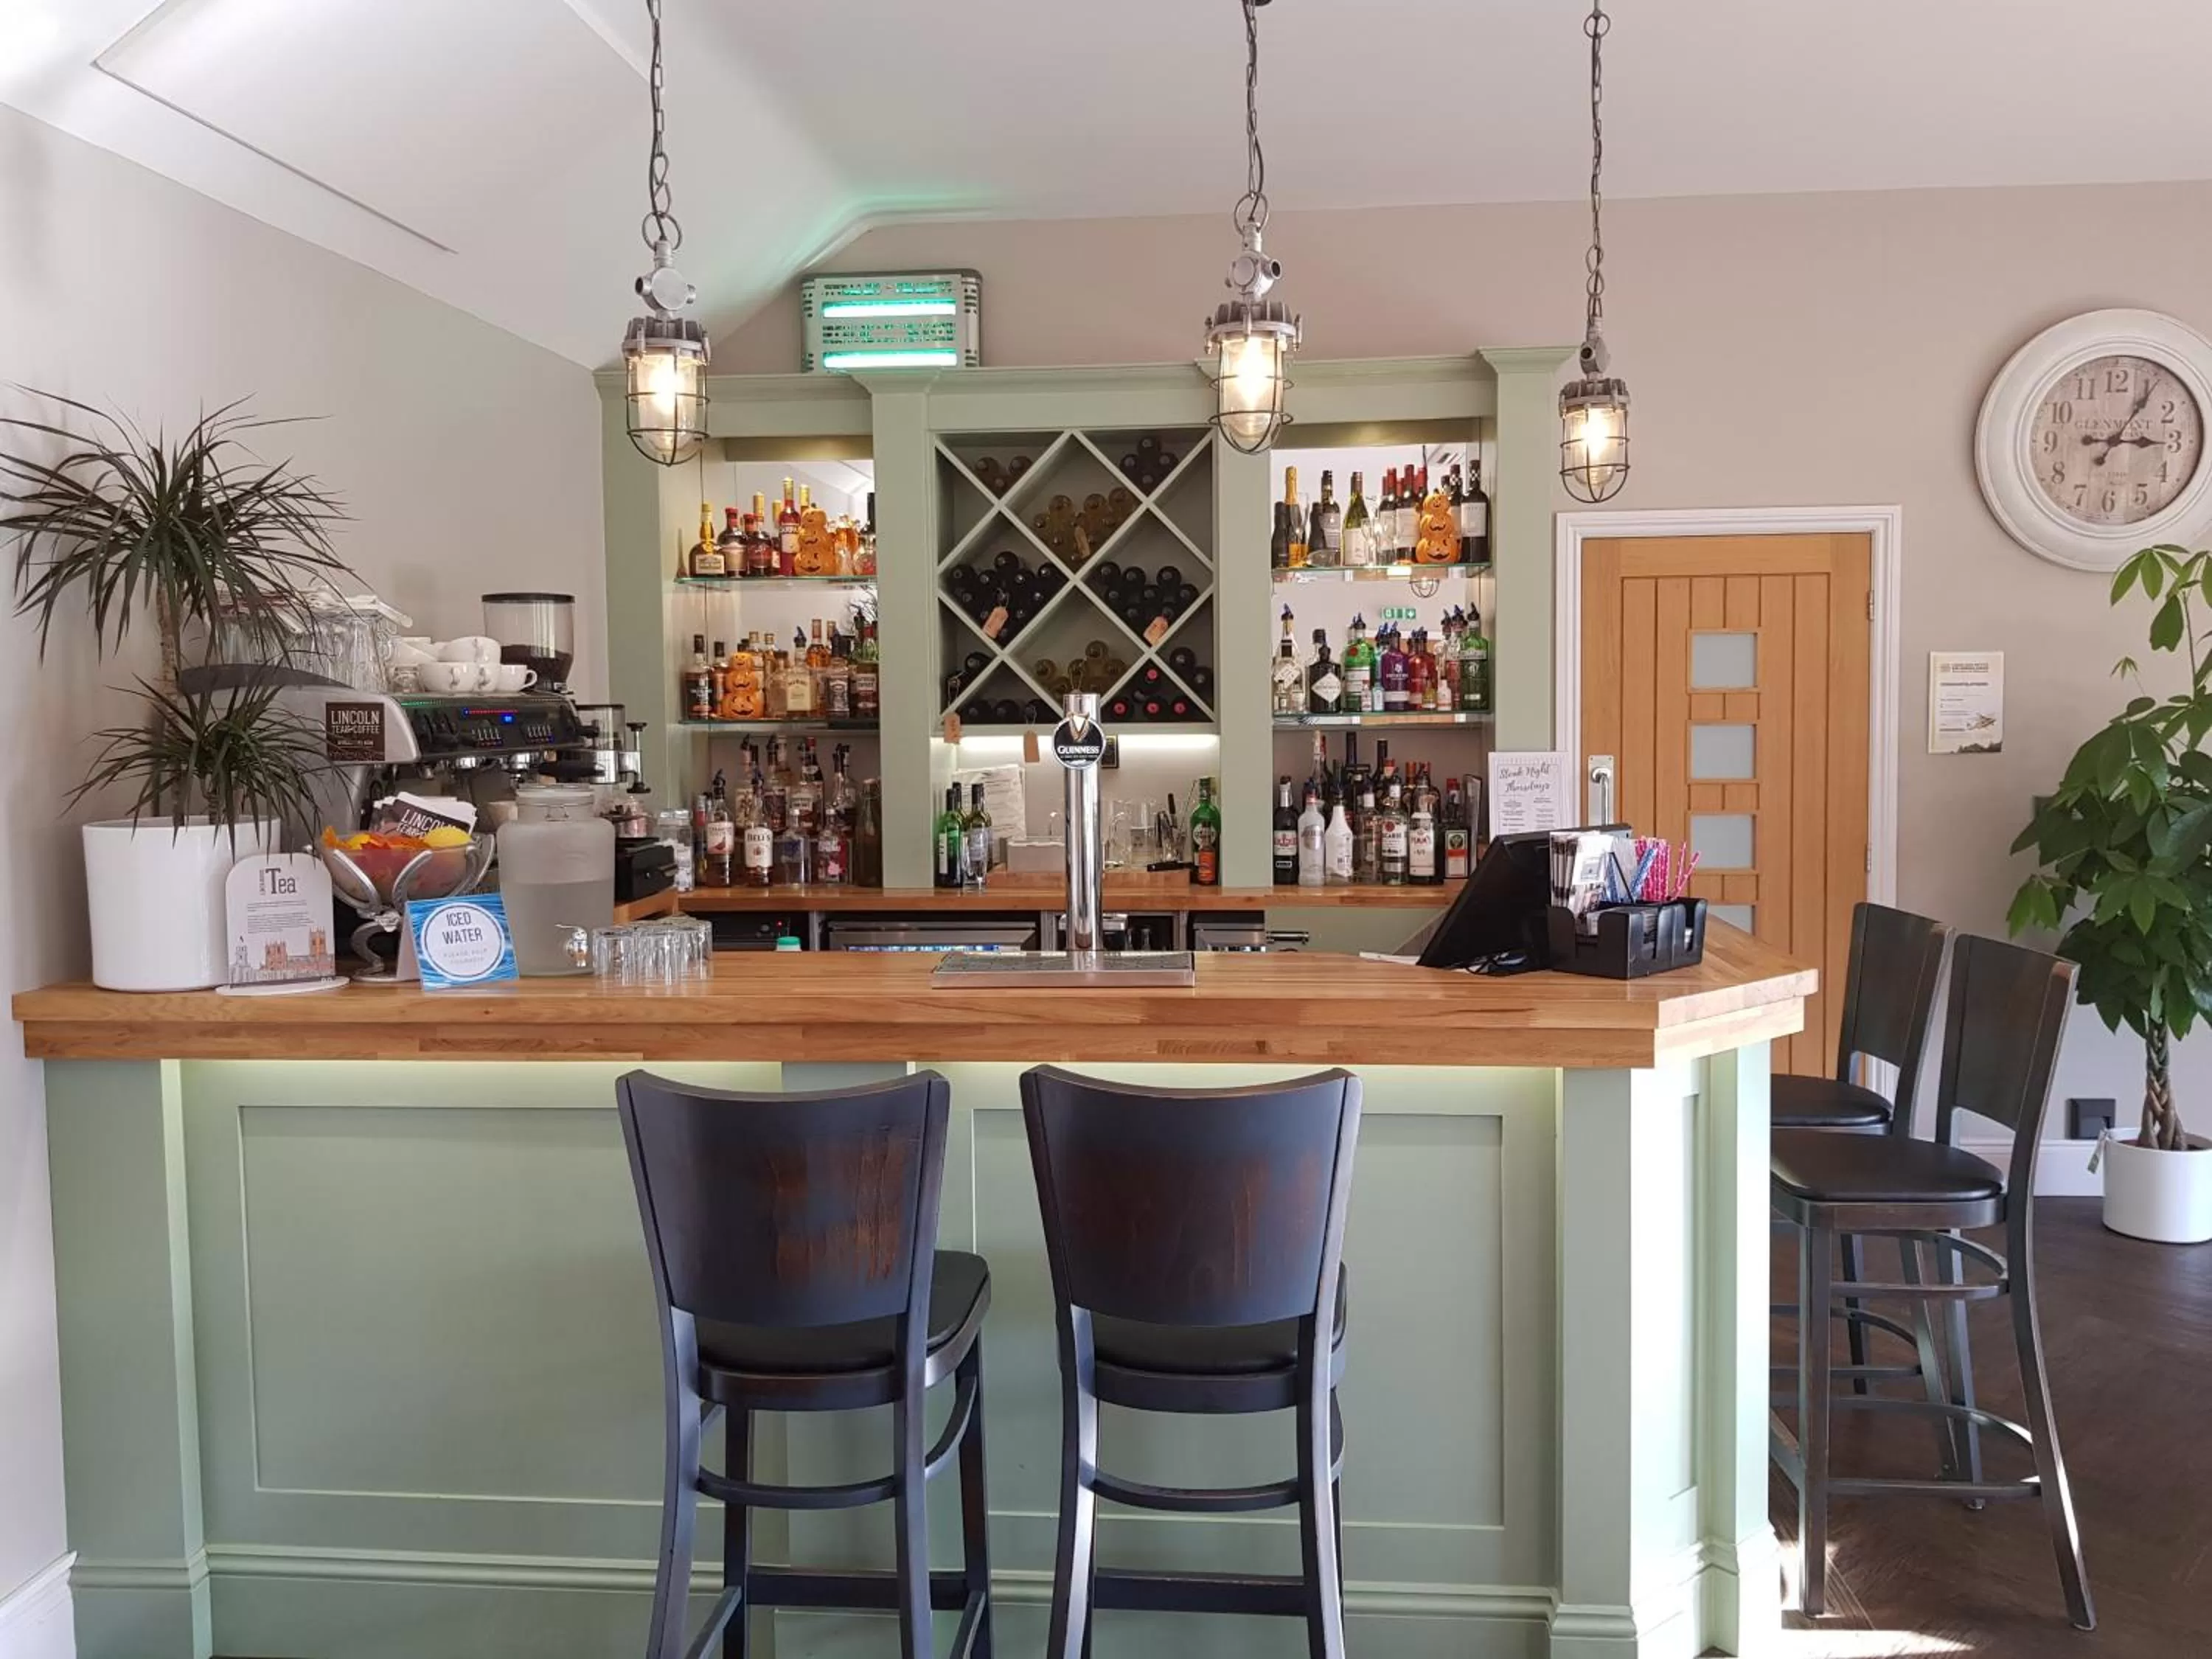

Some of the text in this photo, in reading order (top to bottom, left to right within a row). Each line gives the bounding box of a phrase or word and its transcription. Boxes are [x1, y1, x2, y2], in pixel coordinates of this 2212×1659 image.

[2075, 378, 2096, 400] 11
[2105, 370, 2129, 393] 12
[2052, 401, 2072, 424] 10
[2160, 401, 2174, 424] 2
[2043, 431, 2057, 453] 9
[2167, 431, 2183, 453] 3
[2051, 462, 2065, 484] 8
[2155, 461, 2168, 483] 4
[2073, 484, 2087, 507] 7
[2101, 490, 2115, 512] 6
[2134, 483, 2148, 506] 5
[331, 710, 380, 724] LINCOLN
[1057, 745, 1100, 754] GUINNESS
[265, 868, 296, 894] Tea
[446, 911, 472, 927] ICED
[442, 928, 483, 944] WATER
